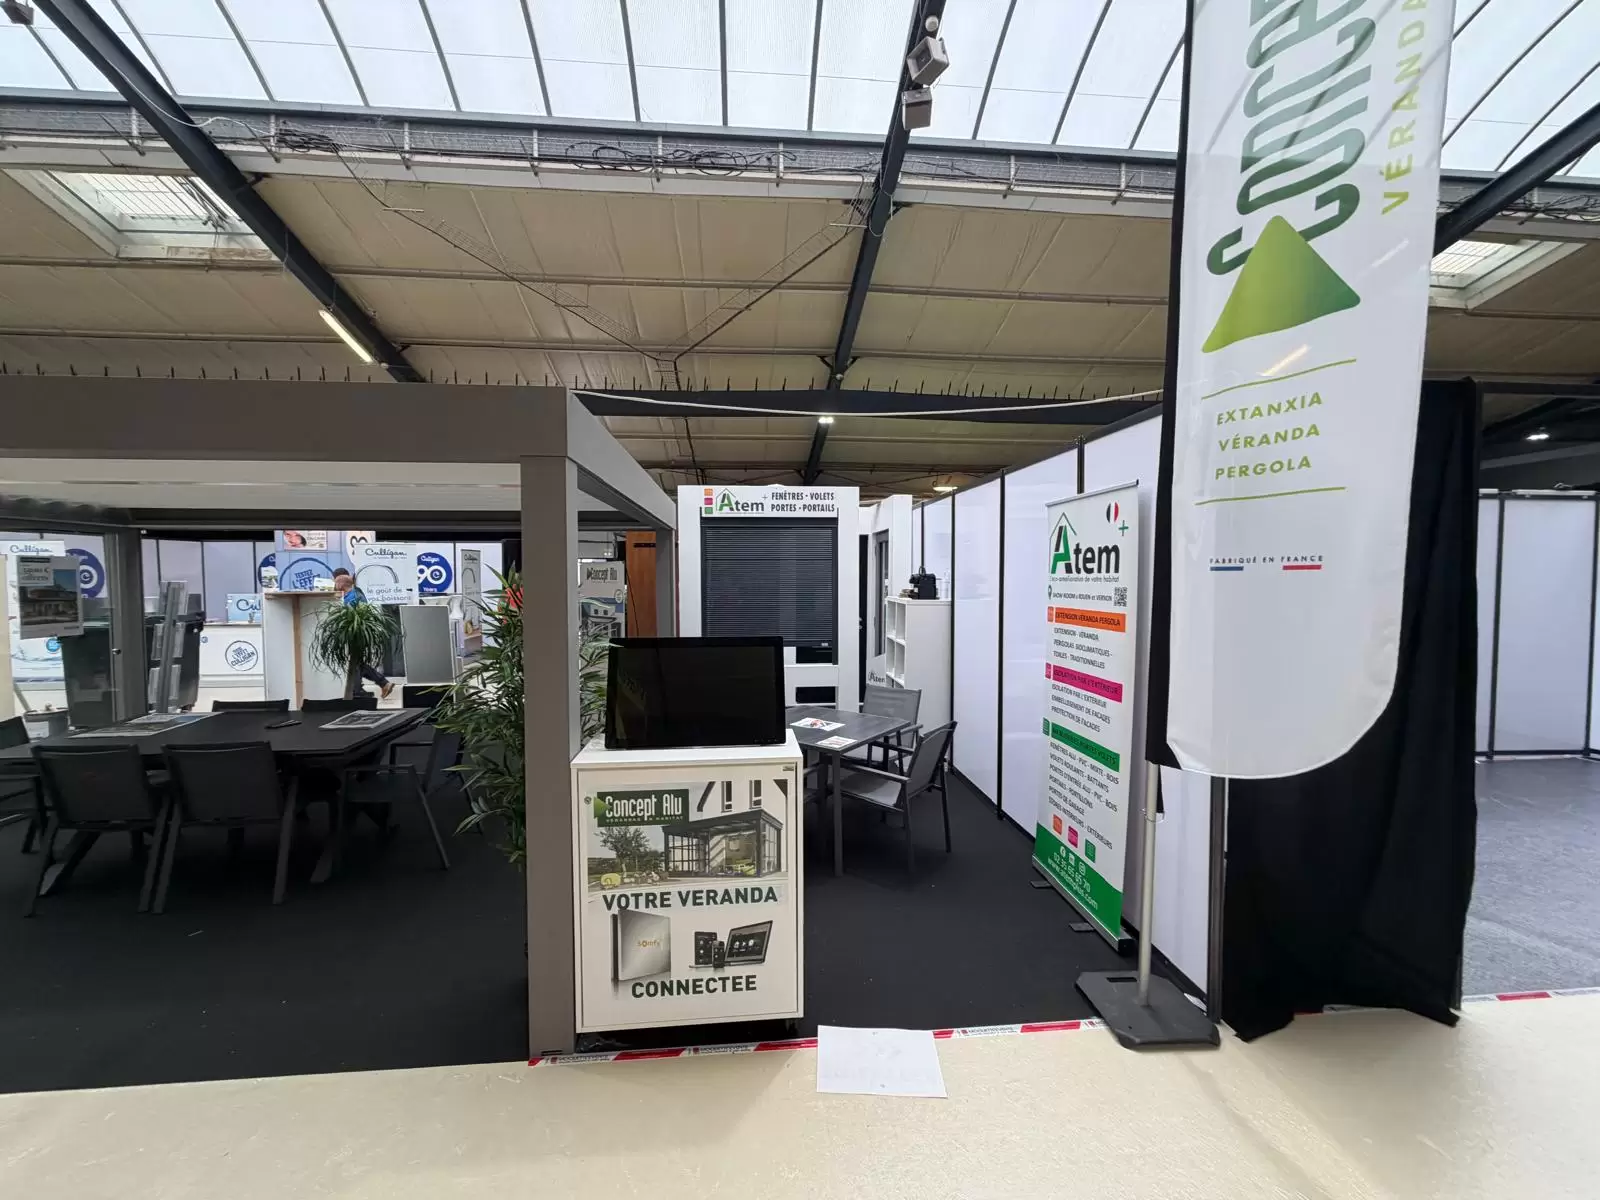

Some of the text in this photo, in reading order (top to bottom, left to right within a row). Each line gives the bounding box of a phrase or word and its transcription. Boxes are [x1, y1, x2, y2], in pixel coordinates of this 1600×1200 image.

[1216, 391, 1323, 426] EXTANXIA
[1218, 423, 1321, 452] VÉRANDA
[1214, 455, 1312, 480] PERGOLA
[718, 492, 765, 512] Atem
[770, 503, 797, 513] PORTES
[802, 503, 836, 513] PORTAILS
[771, 490, 804, 501] FENÊTRES
[809, 491, 835, 501] VOLETS
[364, 547, 408, 560] Culligan
[1050, 524, 1121, 575] Atem
[1209, 554, 1324, 565] FABRIQUÉ EN FRANCE
[605, 793, 683, 821] Concept Alu
[602, 886, 779, 911] VOTRE VERANDA
[631, 974, 758, 999] CONNECTEE
